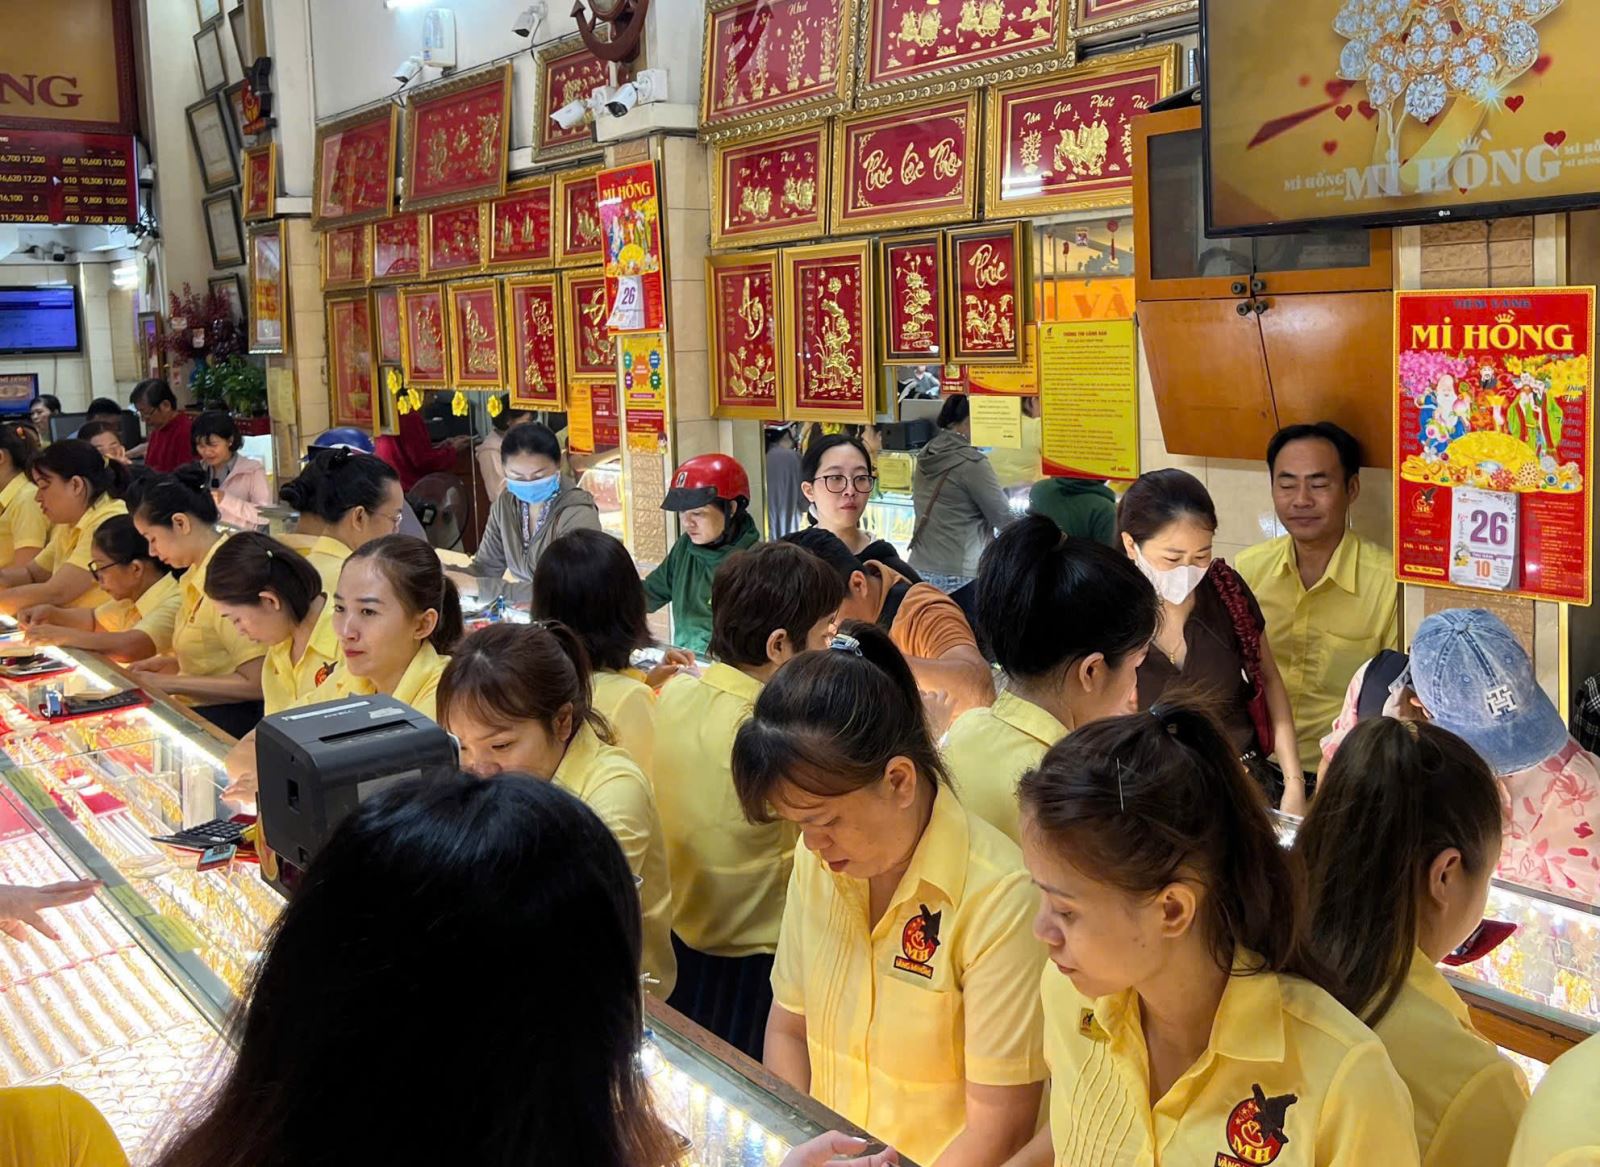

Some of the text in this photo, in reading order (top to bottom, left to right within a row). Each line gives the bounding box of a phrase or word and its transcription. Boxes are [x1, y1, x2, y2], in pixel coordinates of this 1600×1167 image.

[1053, 101, 1072, 120] Gia
[621, 286, 636, 305] 26
[1463, 309, 1574, 350] HỒNG
[1470, 510, 1508, 546] 26
[1475, 559, 1491, 578] 10
